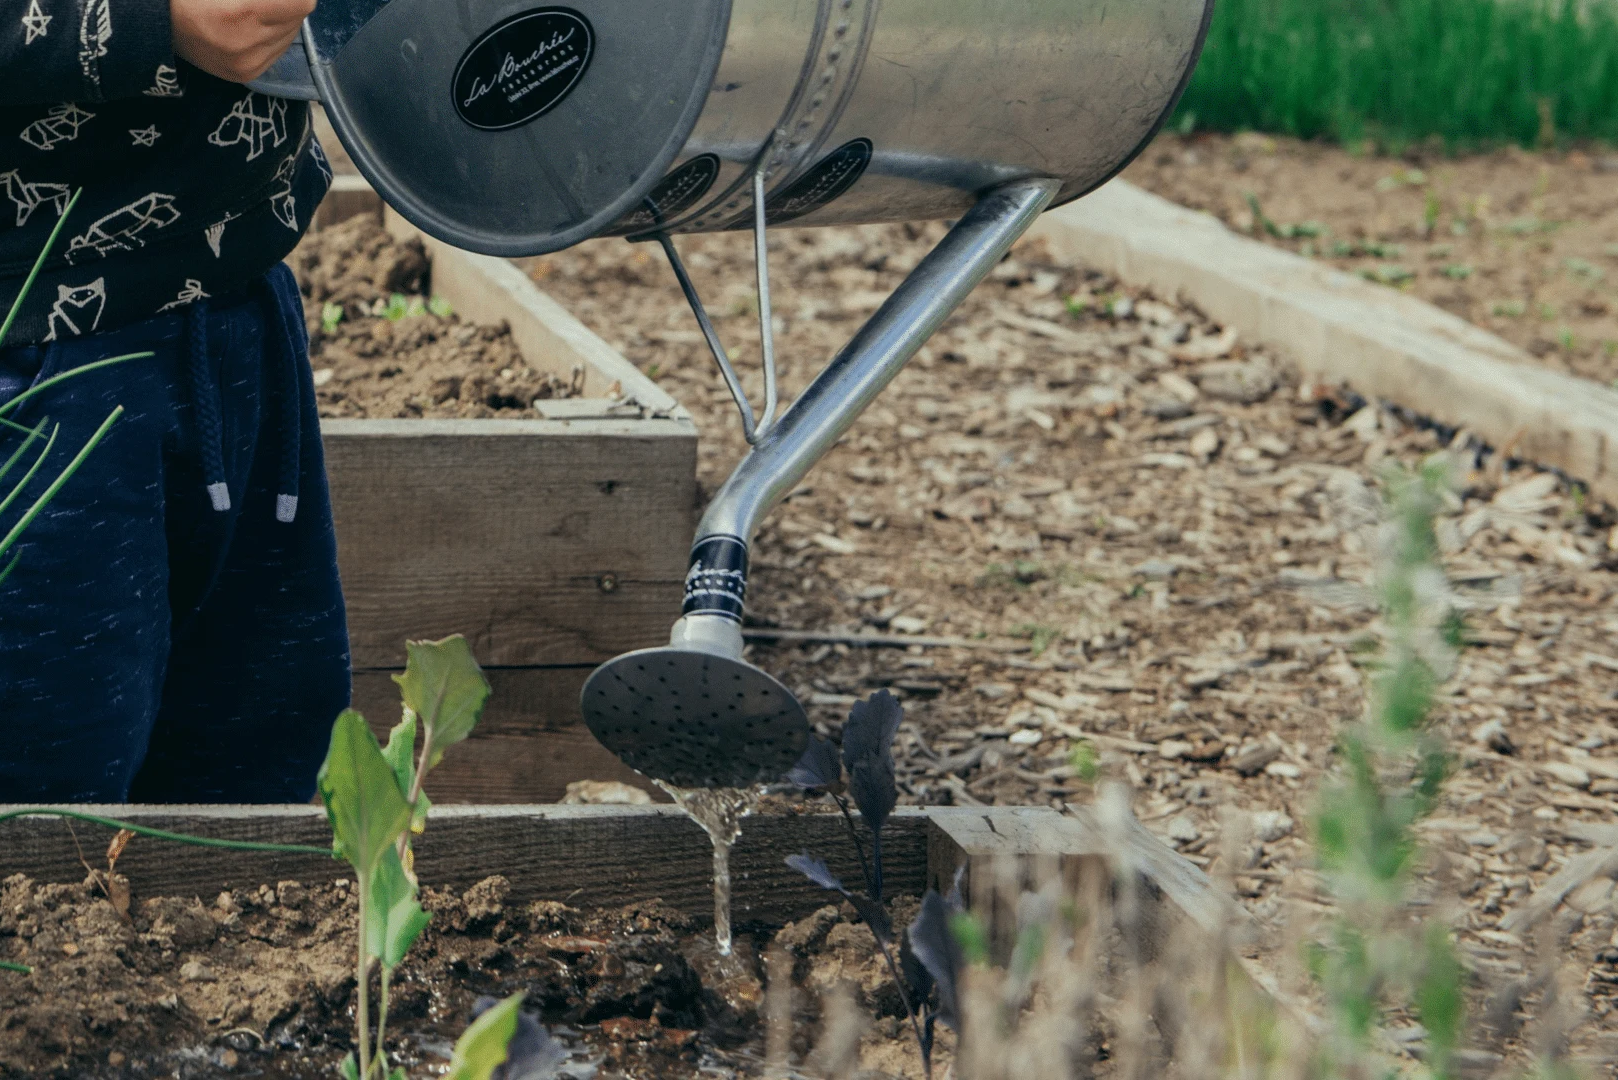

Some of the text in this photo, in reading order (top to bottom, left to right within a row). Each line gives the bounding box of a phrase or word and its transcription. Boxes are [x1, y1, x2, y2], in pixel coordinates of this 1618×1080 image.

[464, 27, 575, 107] La Bouchée
[502, 45, 574, 93] restaurant
